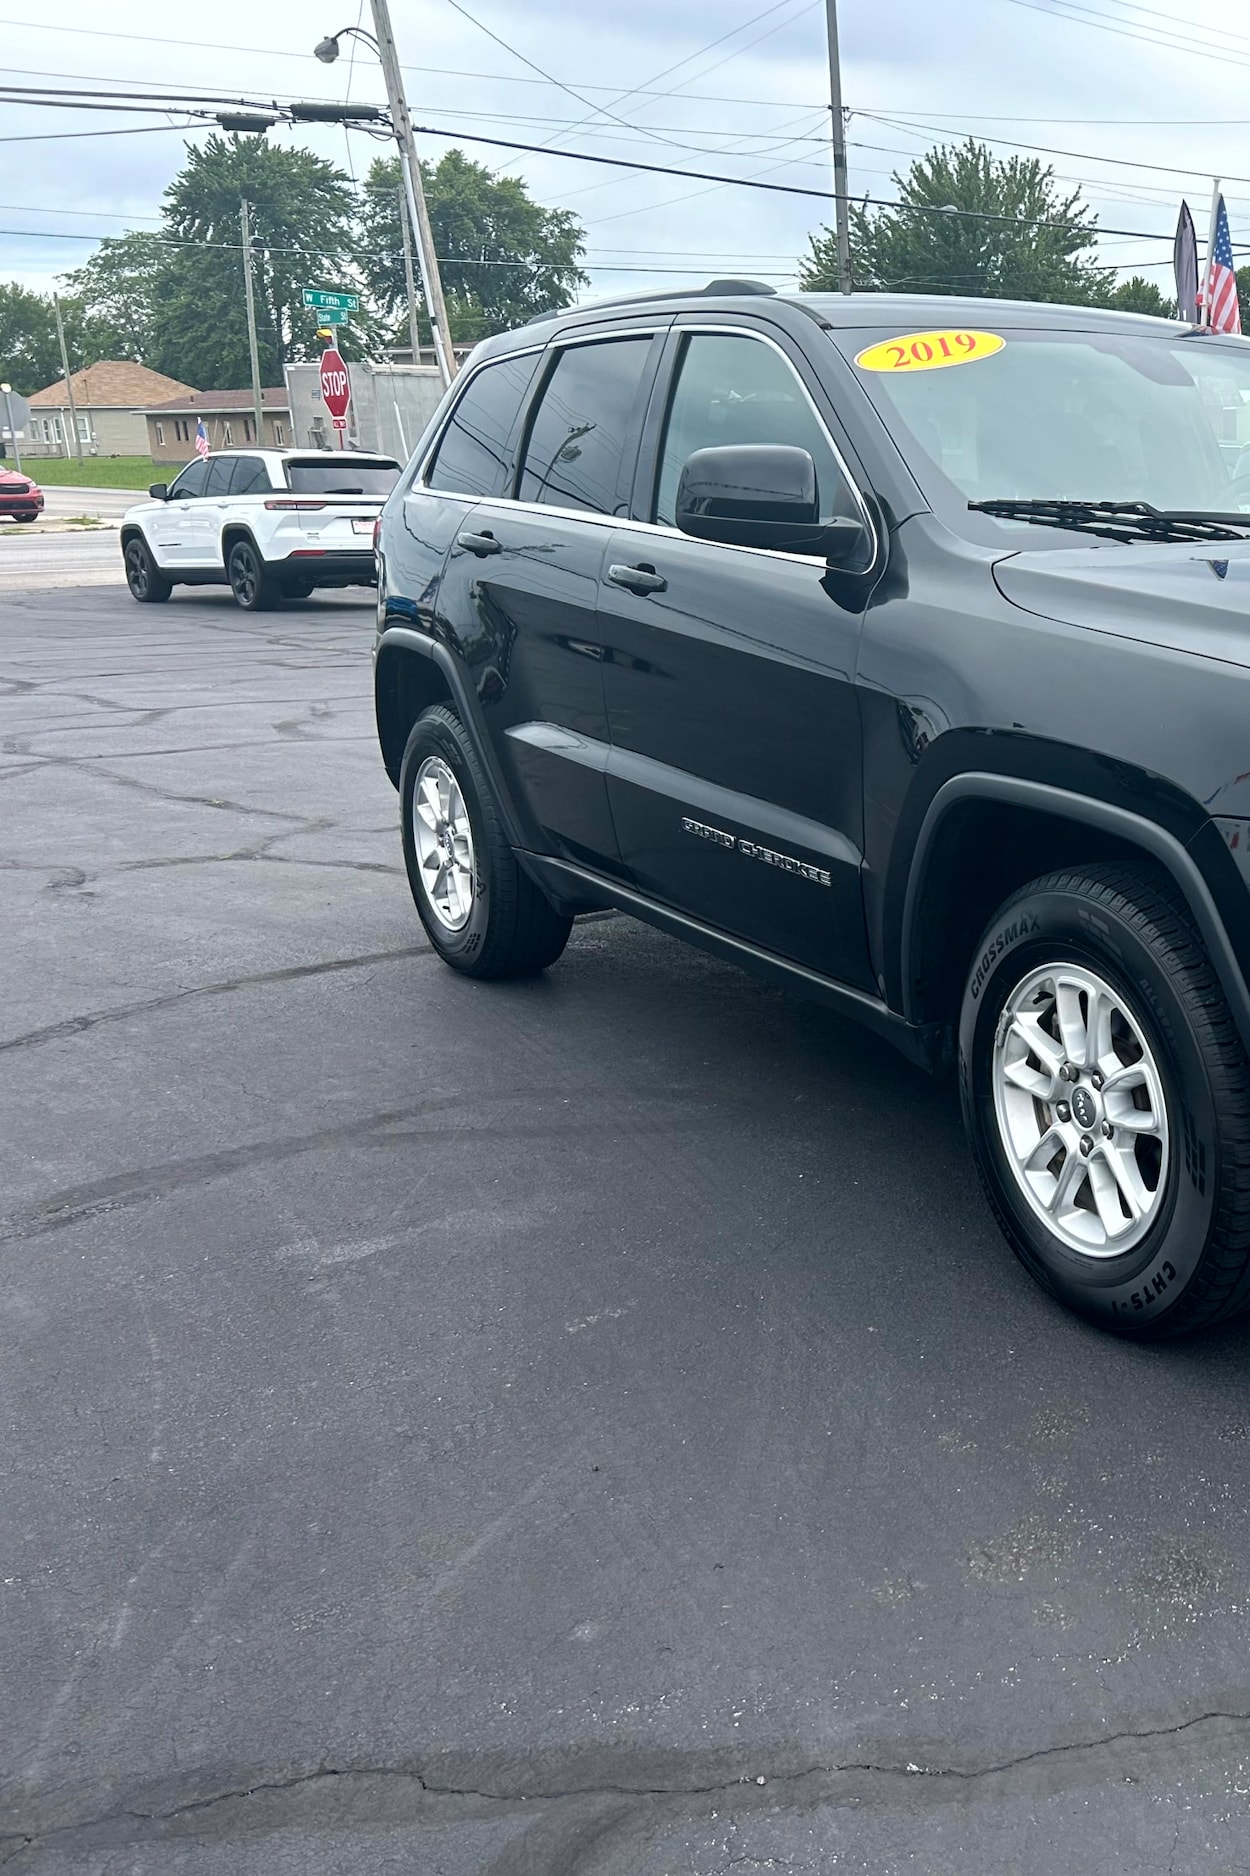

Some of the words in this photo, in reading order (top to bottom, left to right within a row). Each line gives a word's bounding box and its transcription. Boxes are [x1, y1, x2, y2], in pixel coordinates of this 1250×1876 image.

[305, 293, 313, 303] W
[320, 294, 340, 306] Fifth
[347, 298, 357, 309] St
[886, 334, 976, 368] 2019
[322, 370, 347, 397] STOP
[681, 816, 737, 849] GRAND
[737, 839, 832, 887] CHEROKEE
[971, 914, 1041, 1000] CROSSMAX
